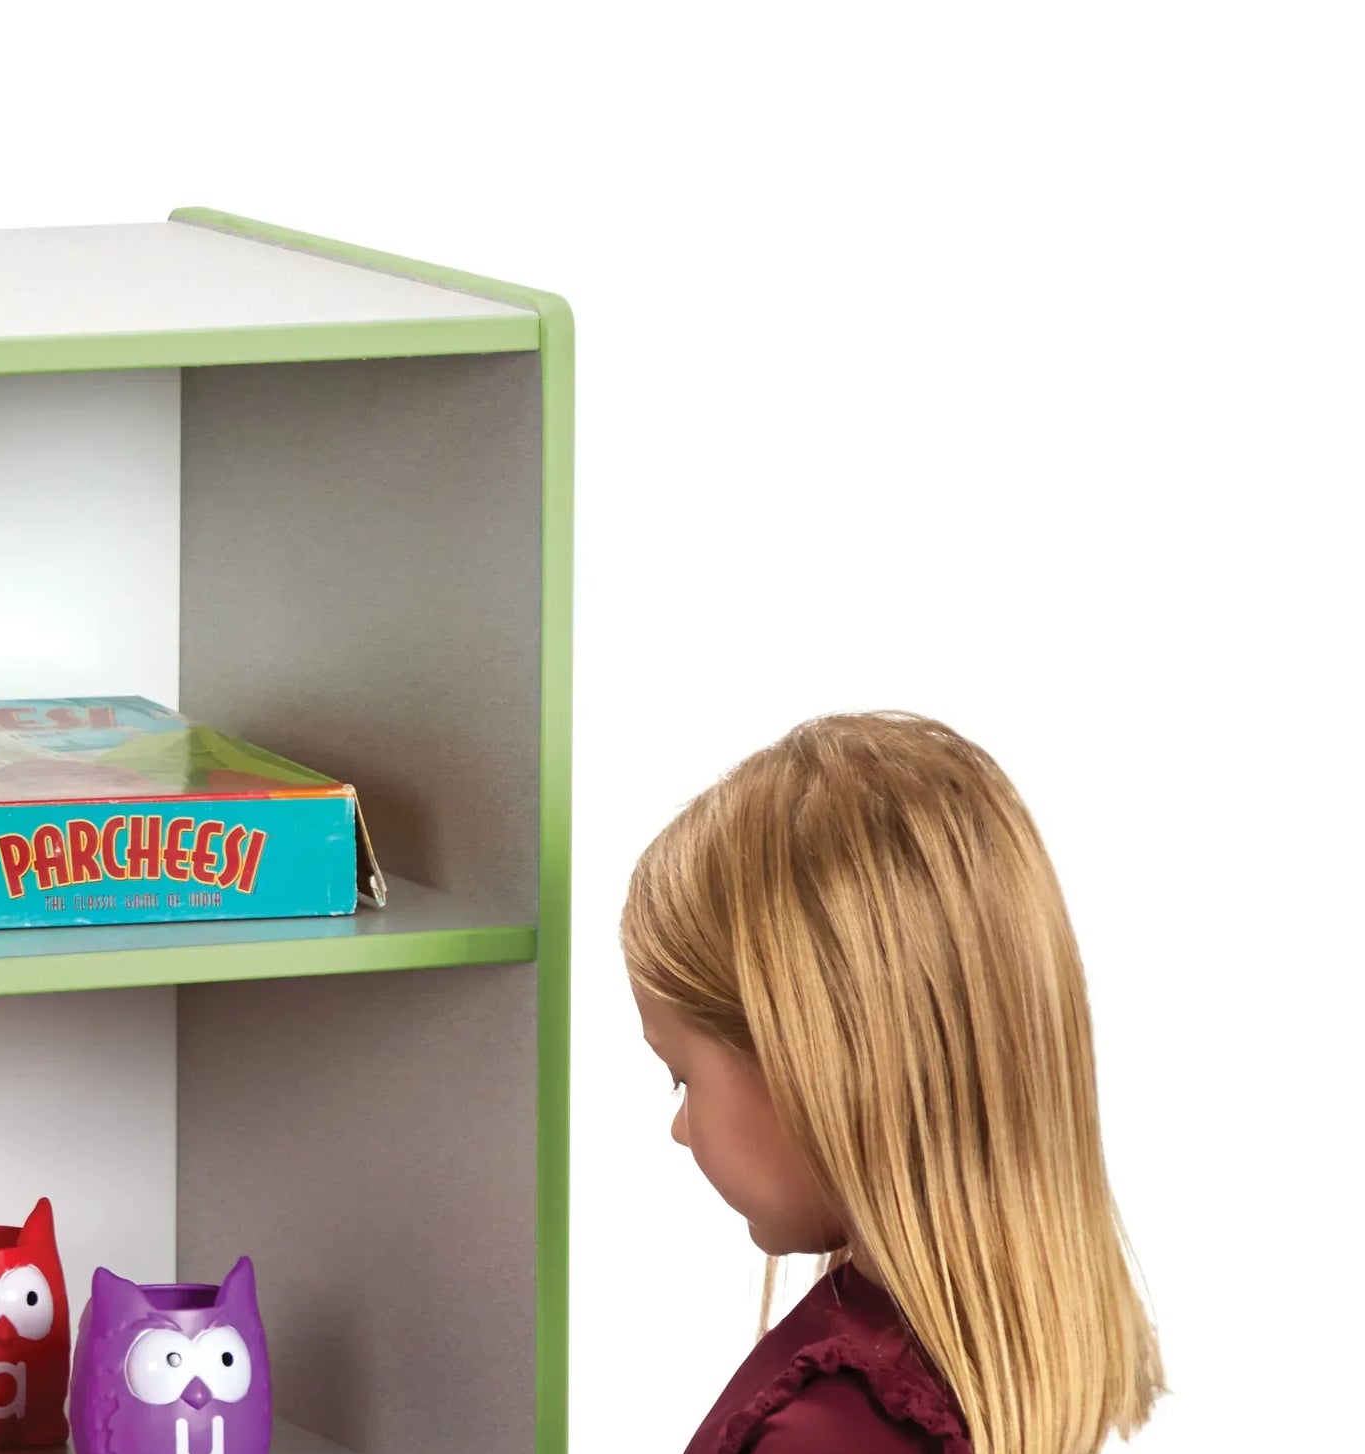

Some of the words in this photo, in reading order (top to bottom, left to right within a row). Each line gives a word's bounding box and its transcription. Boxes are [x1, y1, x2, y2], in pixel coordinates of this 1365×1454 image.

[45, 896, 66, 911] THE
[74, 894, 118, 910] CLASSIC
[125, 893, 160, 909] GAME
[166, 892, 181, 907] OF
[189, 892, 223, 908] INDIA
